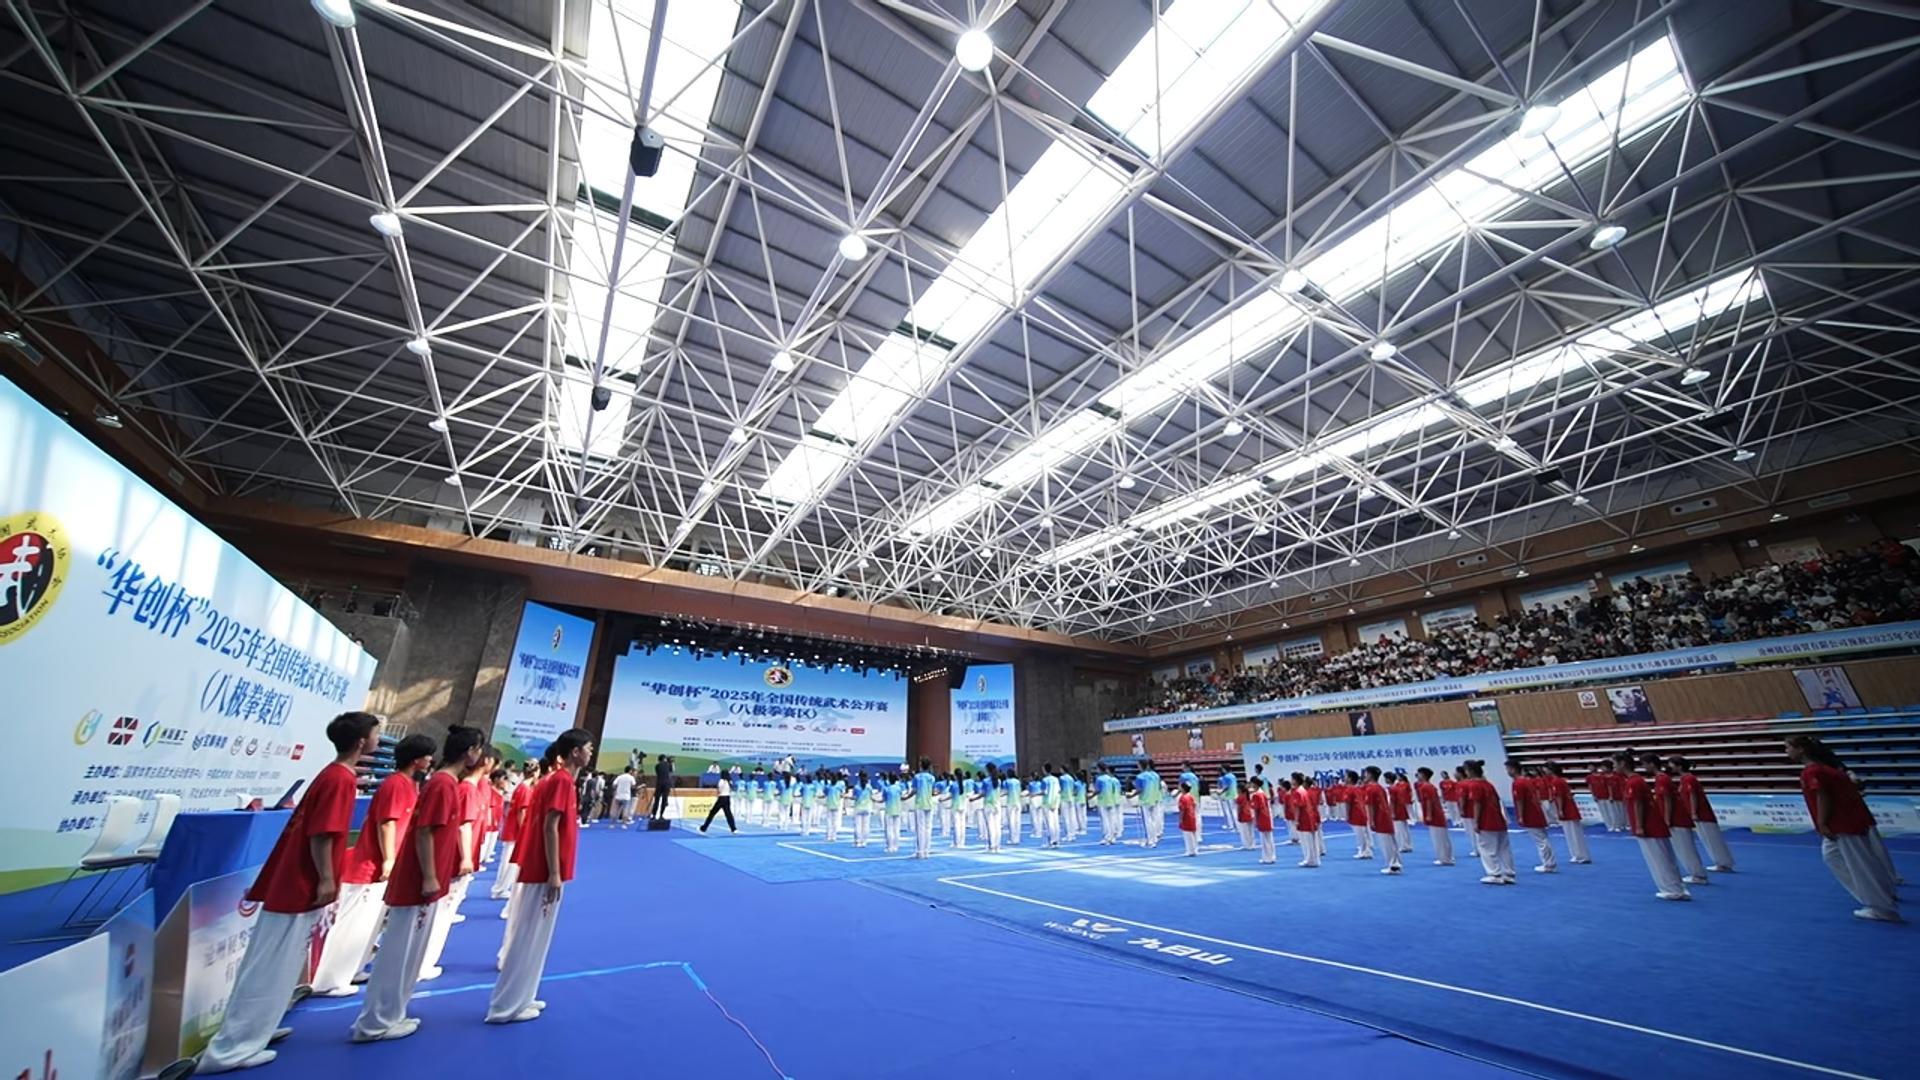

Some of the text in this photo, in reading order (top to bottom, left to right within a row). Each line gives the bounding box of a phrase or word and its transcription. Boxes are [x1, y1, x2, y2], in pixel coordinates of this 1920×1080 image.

[97, 547, 350, 704] “华创杯”2025年全国传统武术公开赛
[200, 669, 293, 727] (八极拳赛区)
[641, 681, 888, 712] “华创杯”2025年全国传统武术公开赛
[729, 703, 817, 720] (八极拳赛区)
